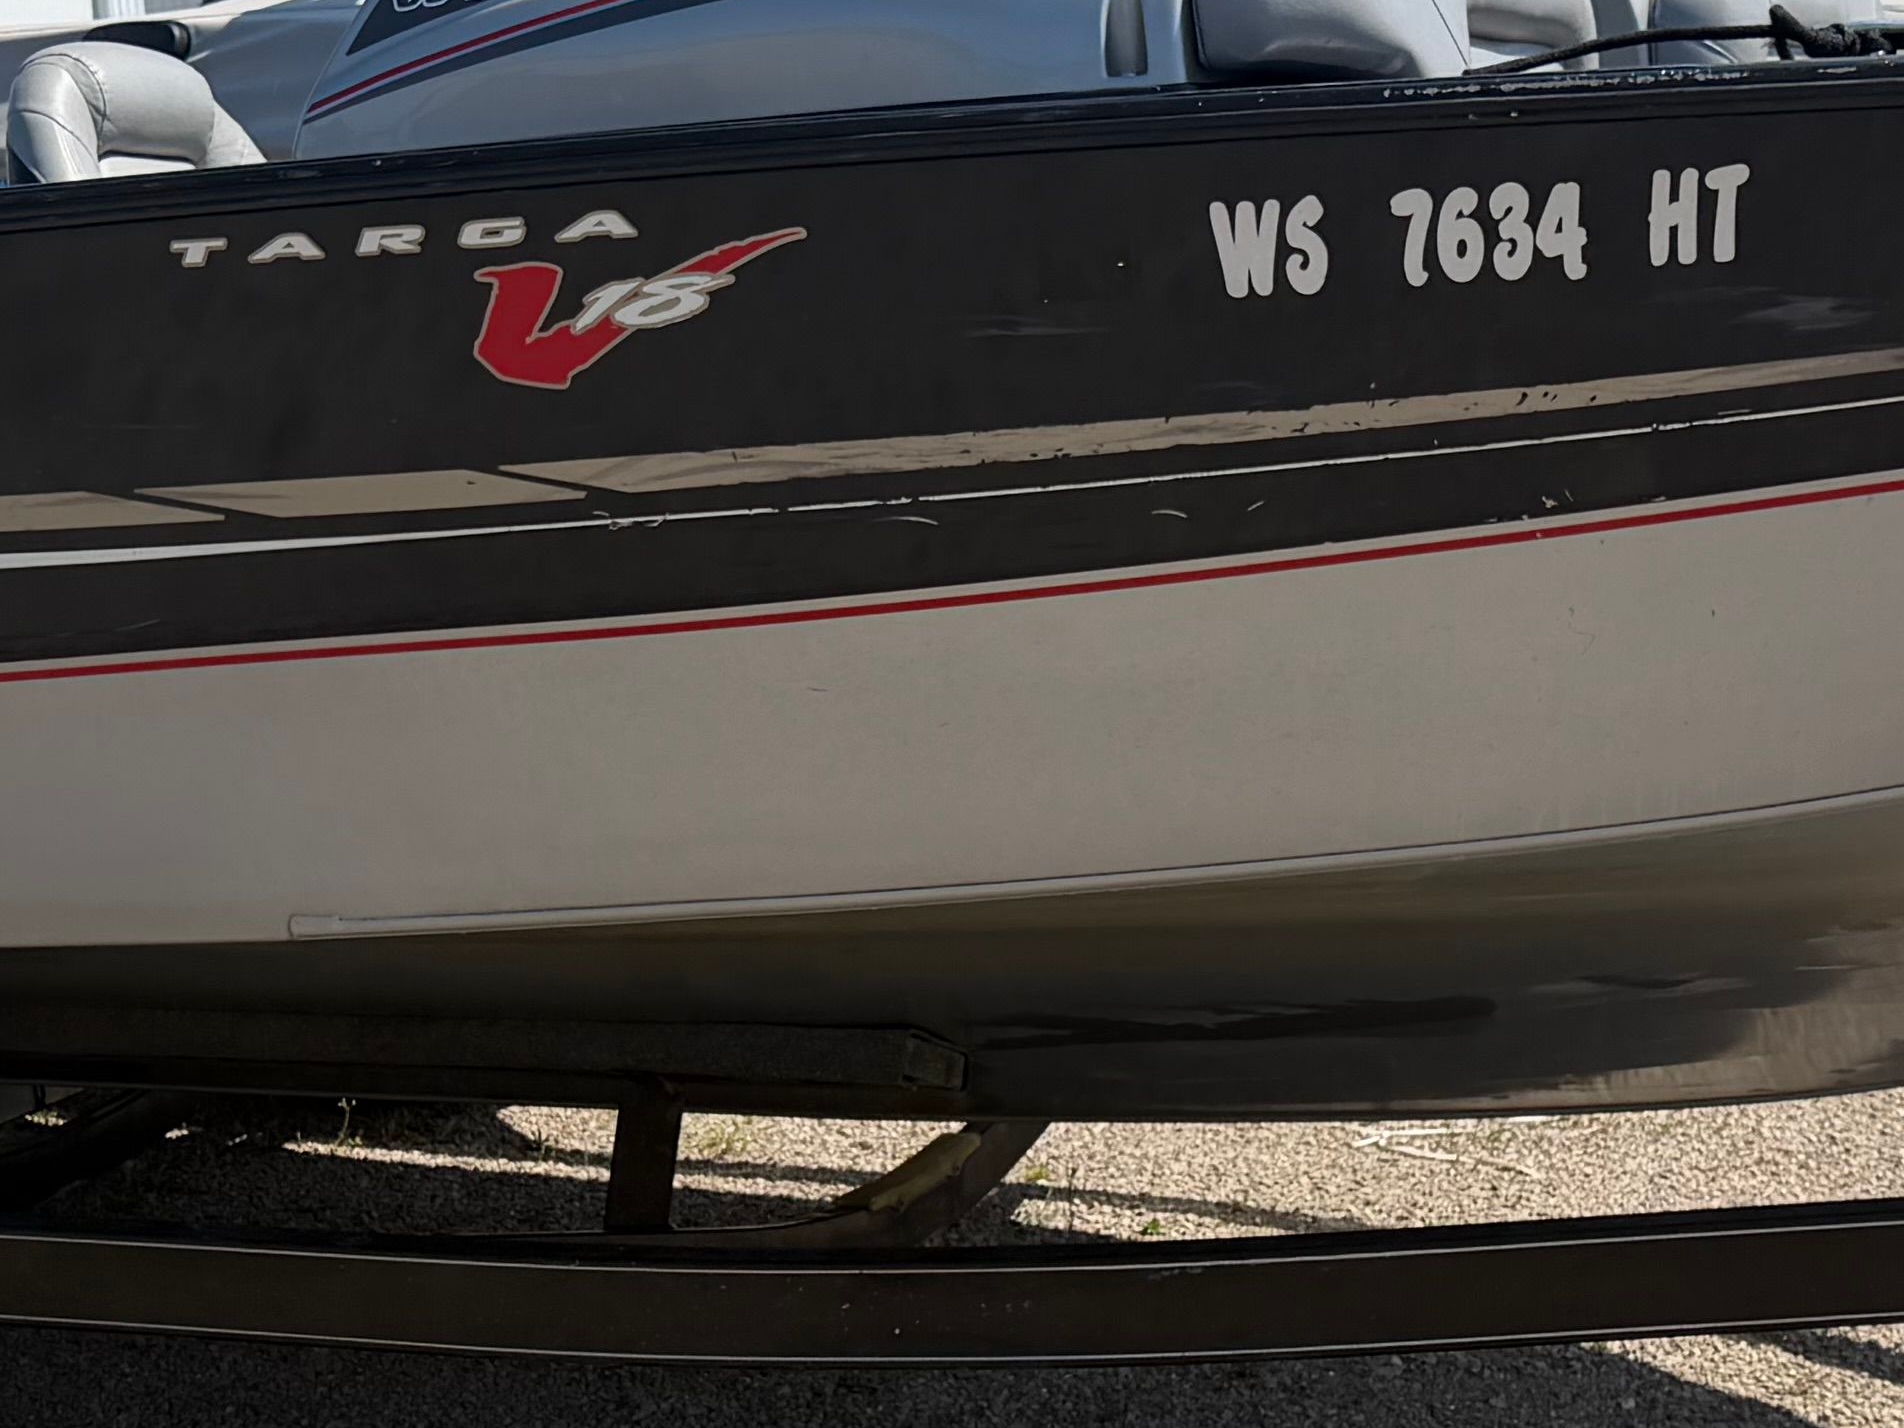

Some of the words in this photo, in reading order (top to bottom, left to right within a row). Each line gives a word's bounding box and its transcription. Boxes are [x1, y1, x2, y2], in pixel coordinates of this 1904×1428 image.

[169, 209, 639, 268] TARGA
[1208, 195, 1329, 299] WS
[1389, 181, 1588, 287] 7634
[1647, 163, 1751, 267] HT
